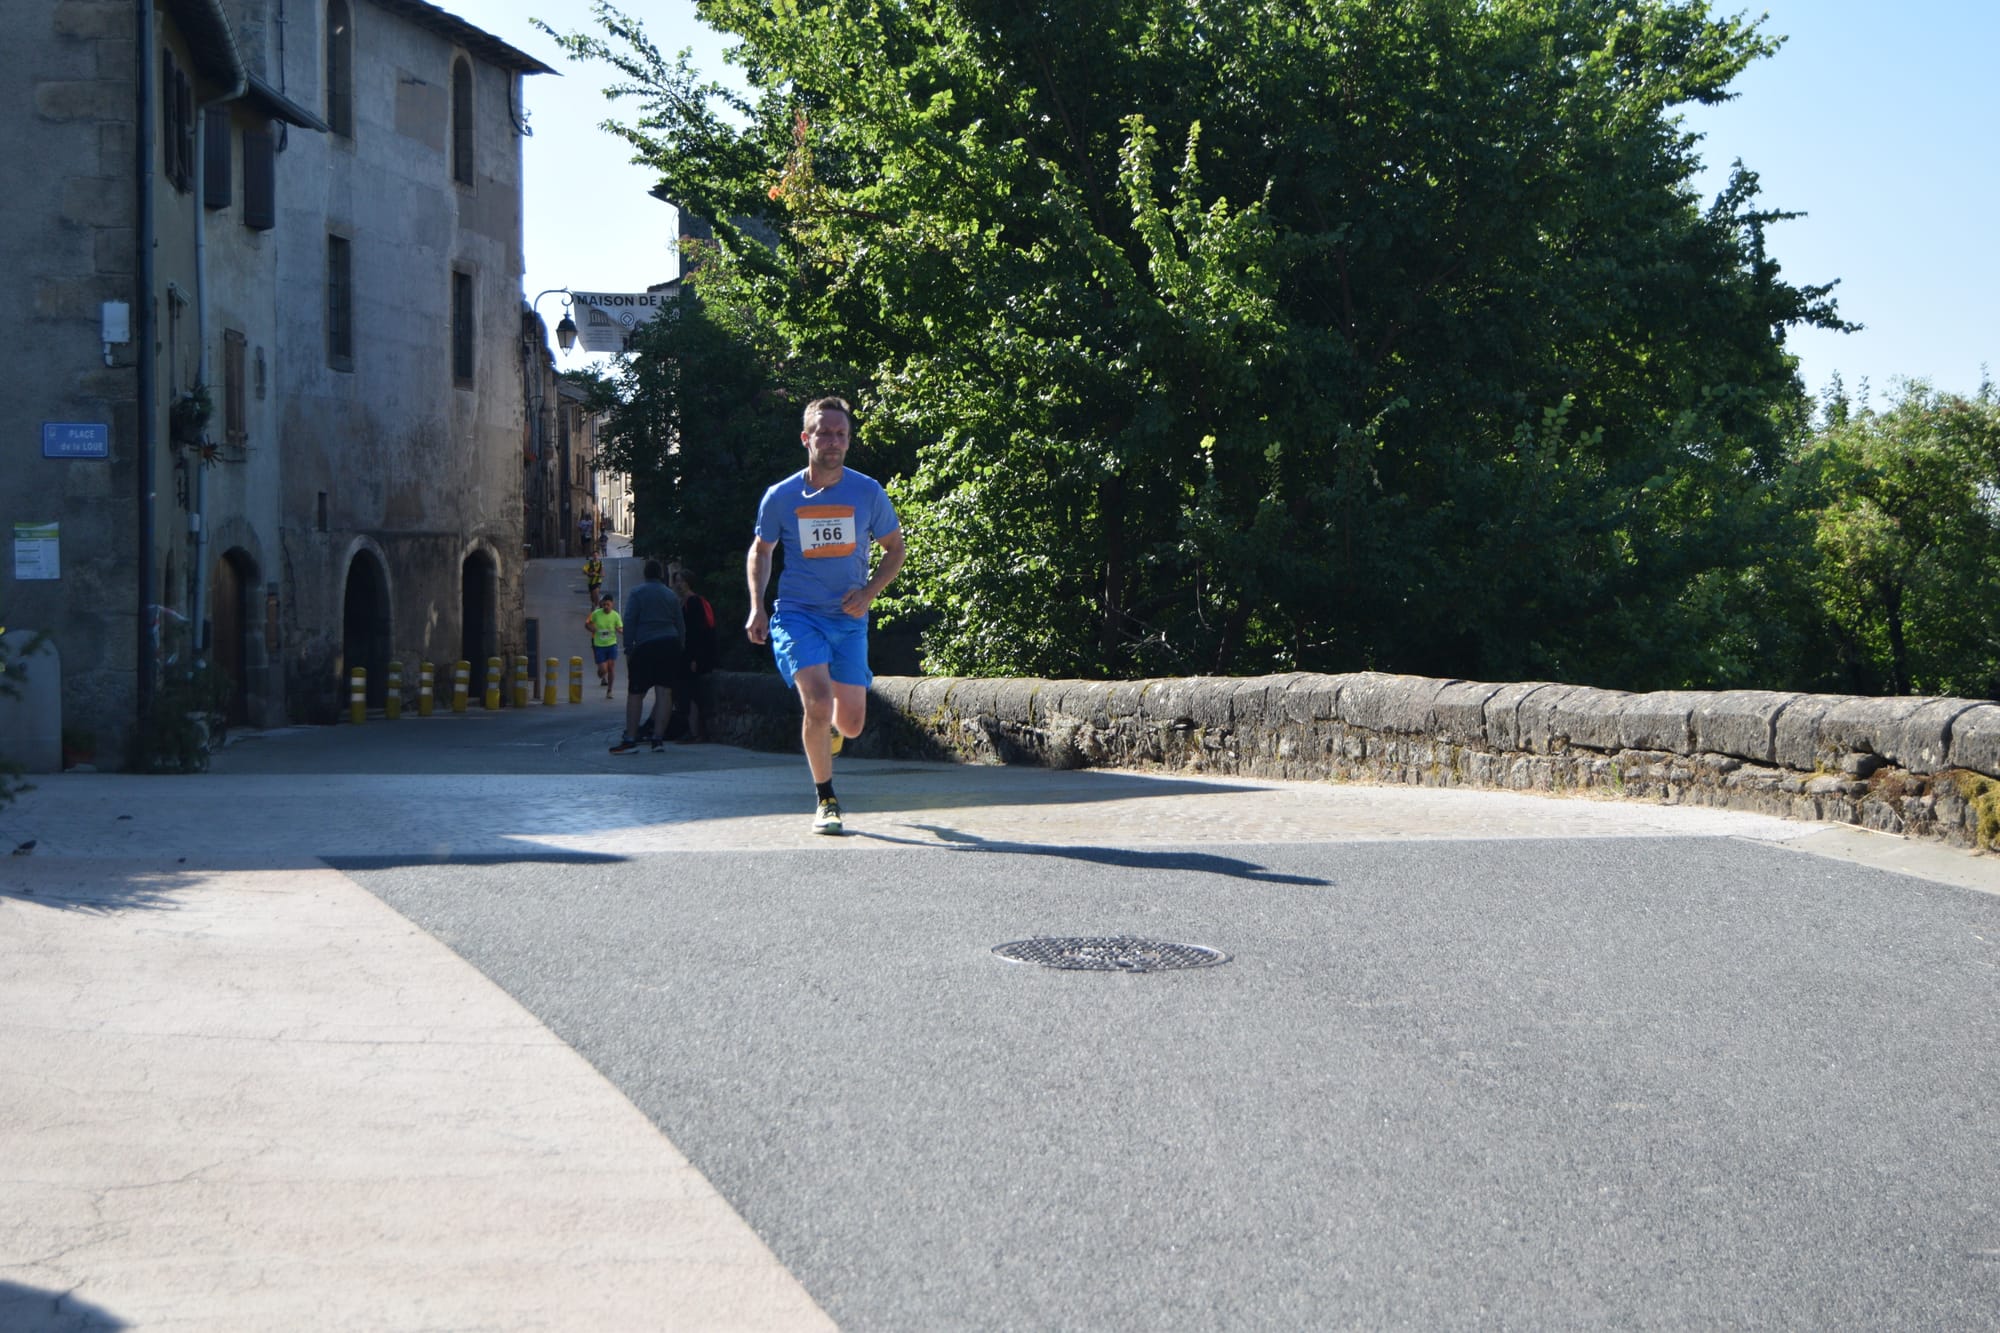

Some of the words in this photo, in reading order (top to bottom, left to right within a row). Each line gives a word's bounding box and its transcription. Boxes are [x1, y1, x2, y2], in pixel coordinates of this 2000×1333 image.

[577, 295, 634, 306] MAISON
[639, 295, 657, 306] DE
[69, 429, 95, 439] PLACE
[812, 527, 842, 541] 166
